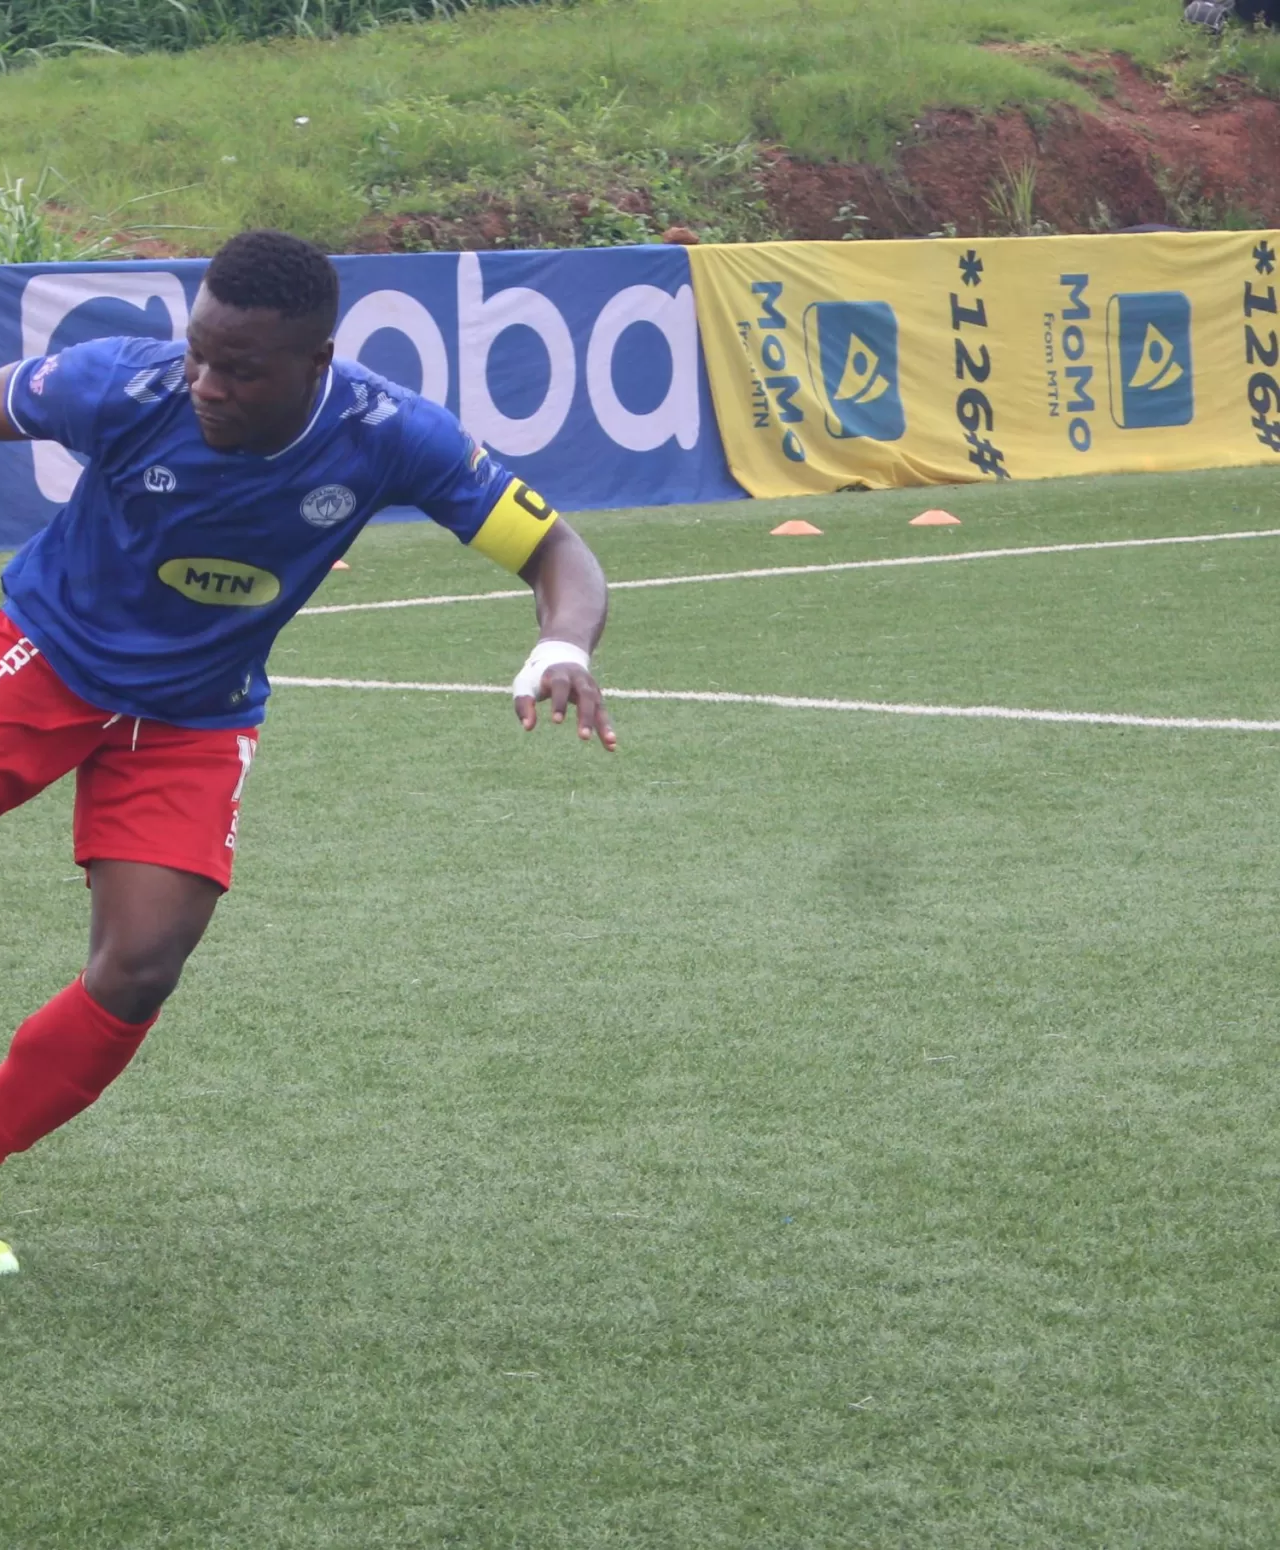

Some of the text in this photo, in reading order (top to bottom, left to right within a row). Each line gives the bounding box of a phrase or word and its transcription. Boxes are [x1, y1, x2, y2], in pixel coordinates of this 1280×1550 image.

[331, 251, 701, 458] oba
[751, 281, 806, 462] MoMo
[751, 379, 771, 428] MTN
[1047, 369, 1061, 417] MTN
[1059, 273, 1095, 452] MoMo
[184, 567, 255, 594] MTN
